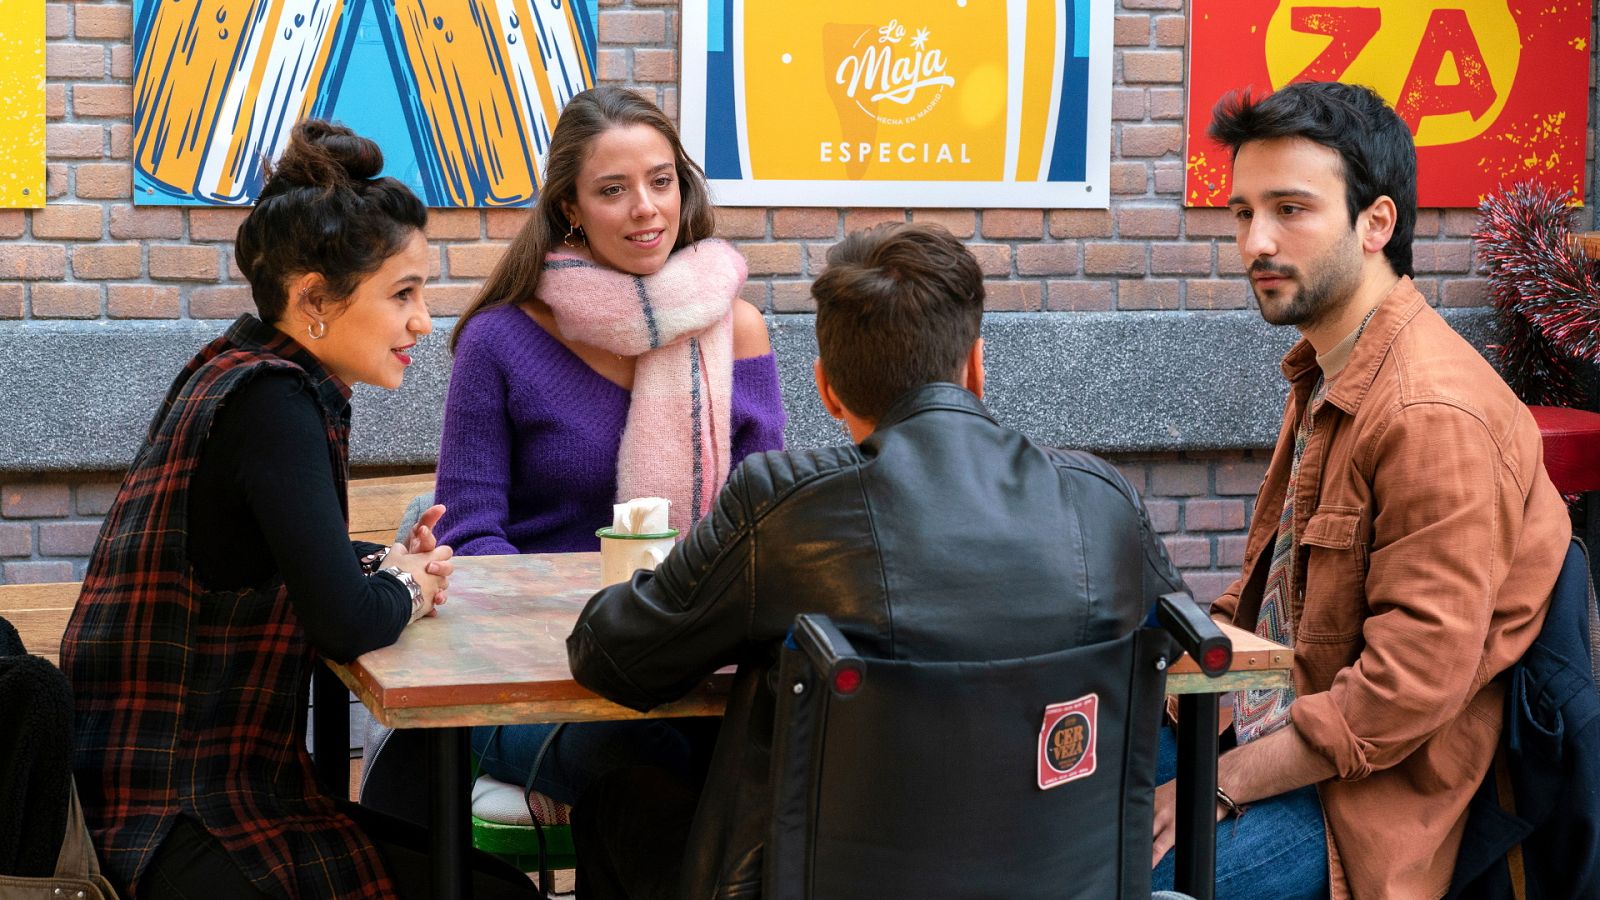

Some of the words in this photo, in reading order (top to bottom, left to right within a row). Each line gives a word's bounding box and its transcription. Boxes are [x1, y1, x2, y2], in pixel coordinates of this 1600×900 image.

[878, 19, 907, 43] La
[835, 44, 956, 105] Maja
[1288, 6, 1498, 138] ZA
[876, 115, 904, 126] HECHA
[905, 116, 917, 125] EN
[917, 93, 942, 119] MADRID
[820, 141, 972, 164] ESPECIAL
[1053, 725, 1084, 748] CER
[1053, 741, 1084, 761] VEZA
